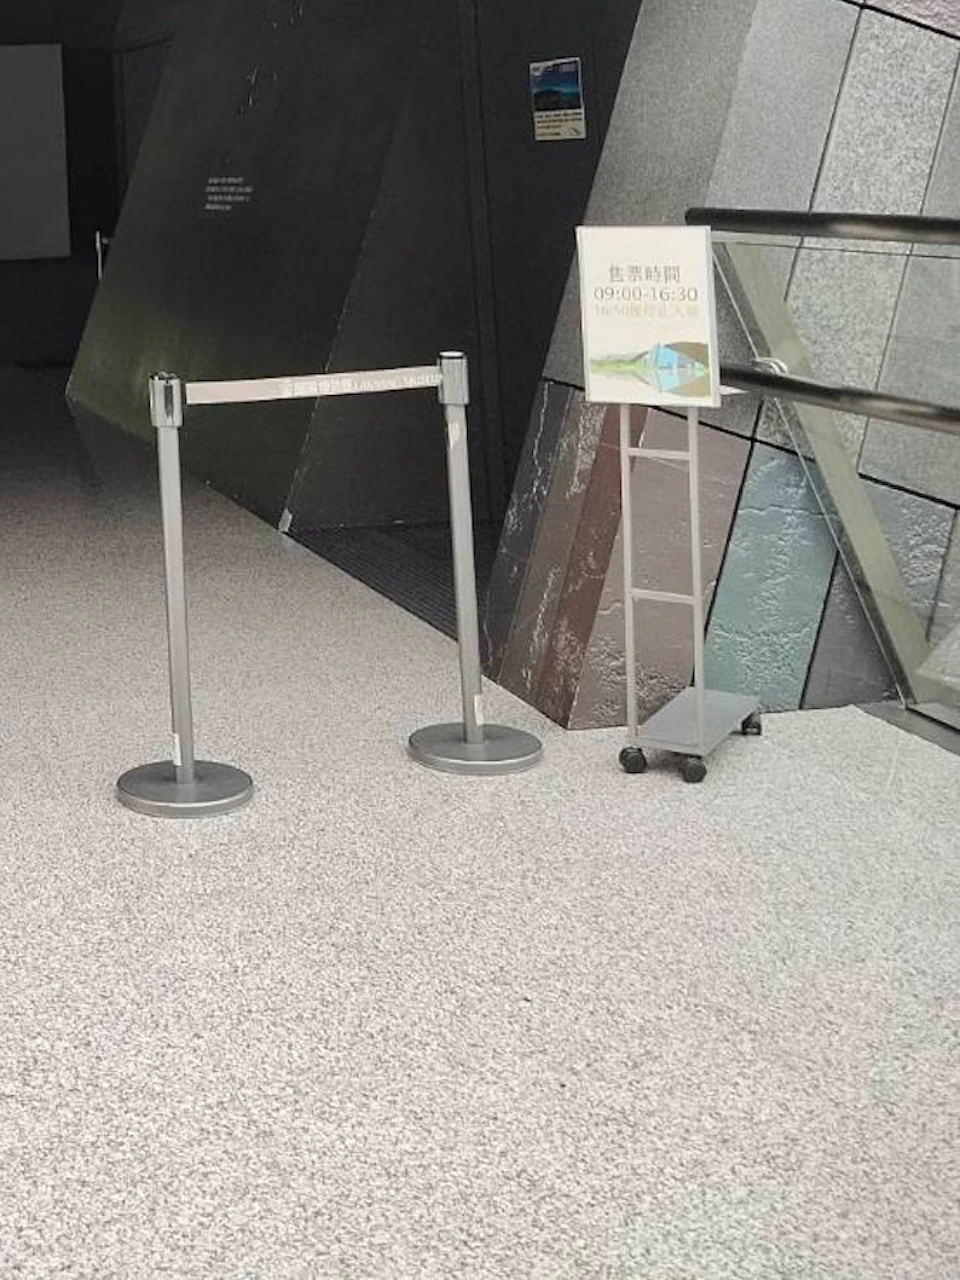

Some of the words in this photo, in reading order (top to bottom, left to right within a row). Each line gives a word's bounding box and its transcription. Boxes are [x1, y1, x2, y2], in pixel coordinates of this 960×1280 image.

[608, 263, 681, 284] 售票時間
[593, 286, 699, 301] 09:00-16:30
